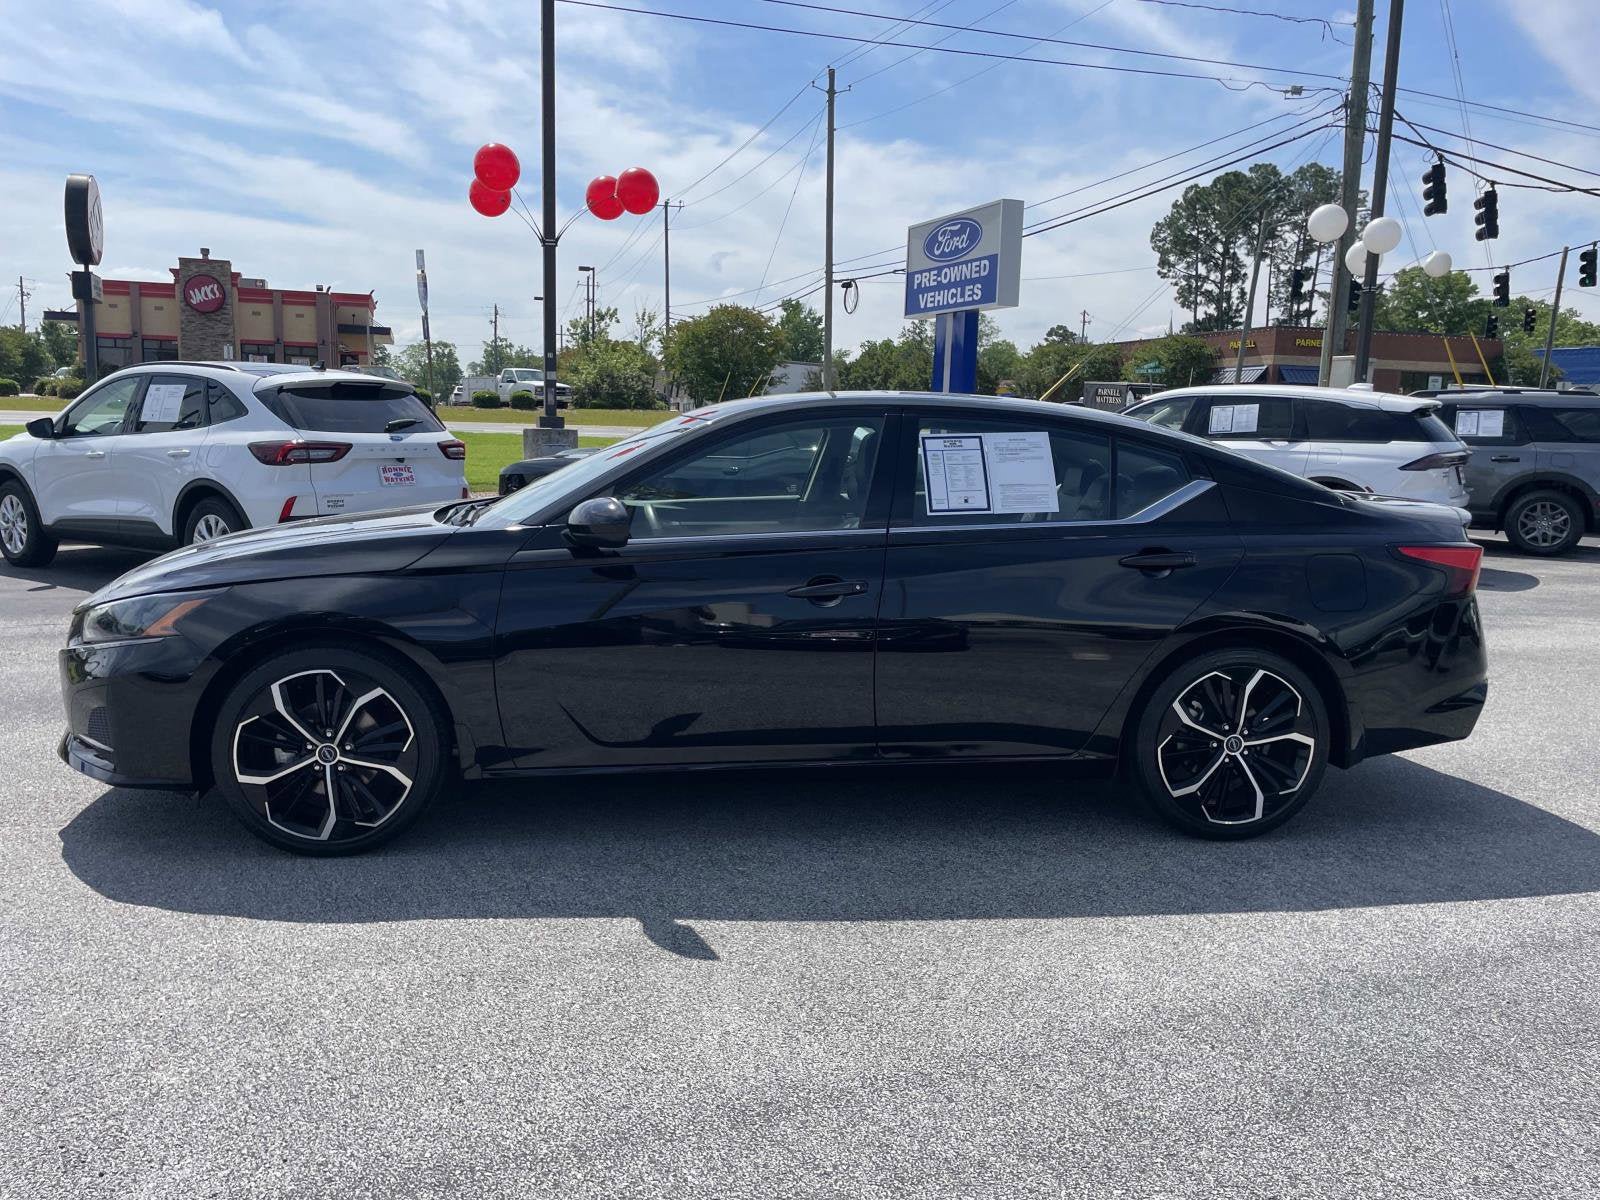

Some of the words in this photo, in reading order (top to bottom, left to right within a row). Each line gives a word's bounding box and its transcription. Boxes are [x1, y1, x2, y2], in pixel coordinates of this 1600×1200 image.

[934, 224, 970, 255] Ford
[914, 260, 989, 289] PRE-OWNED
[919, 284, 982, 309] VEHICLES
[1229, 339, 1256, 349] PARELL
[1296, 338, 1322, 347] PARNE
[1097, 388, 1121, 397] PARNELL
[1095, 396, 1122, 405] MATTRESS
[381, 466, 413, 475] RONNIE
[384, 475, 415, 483] WATKINS
